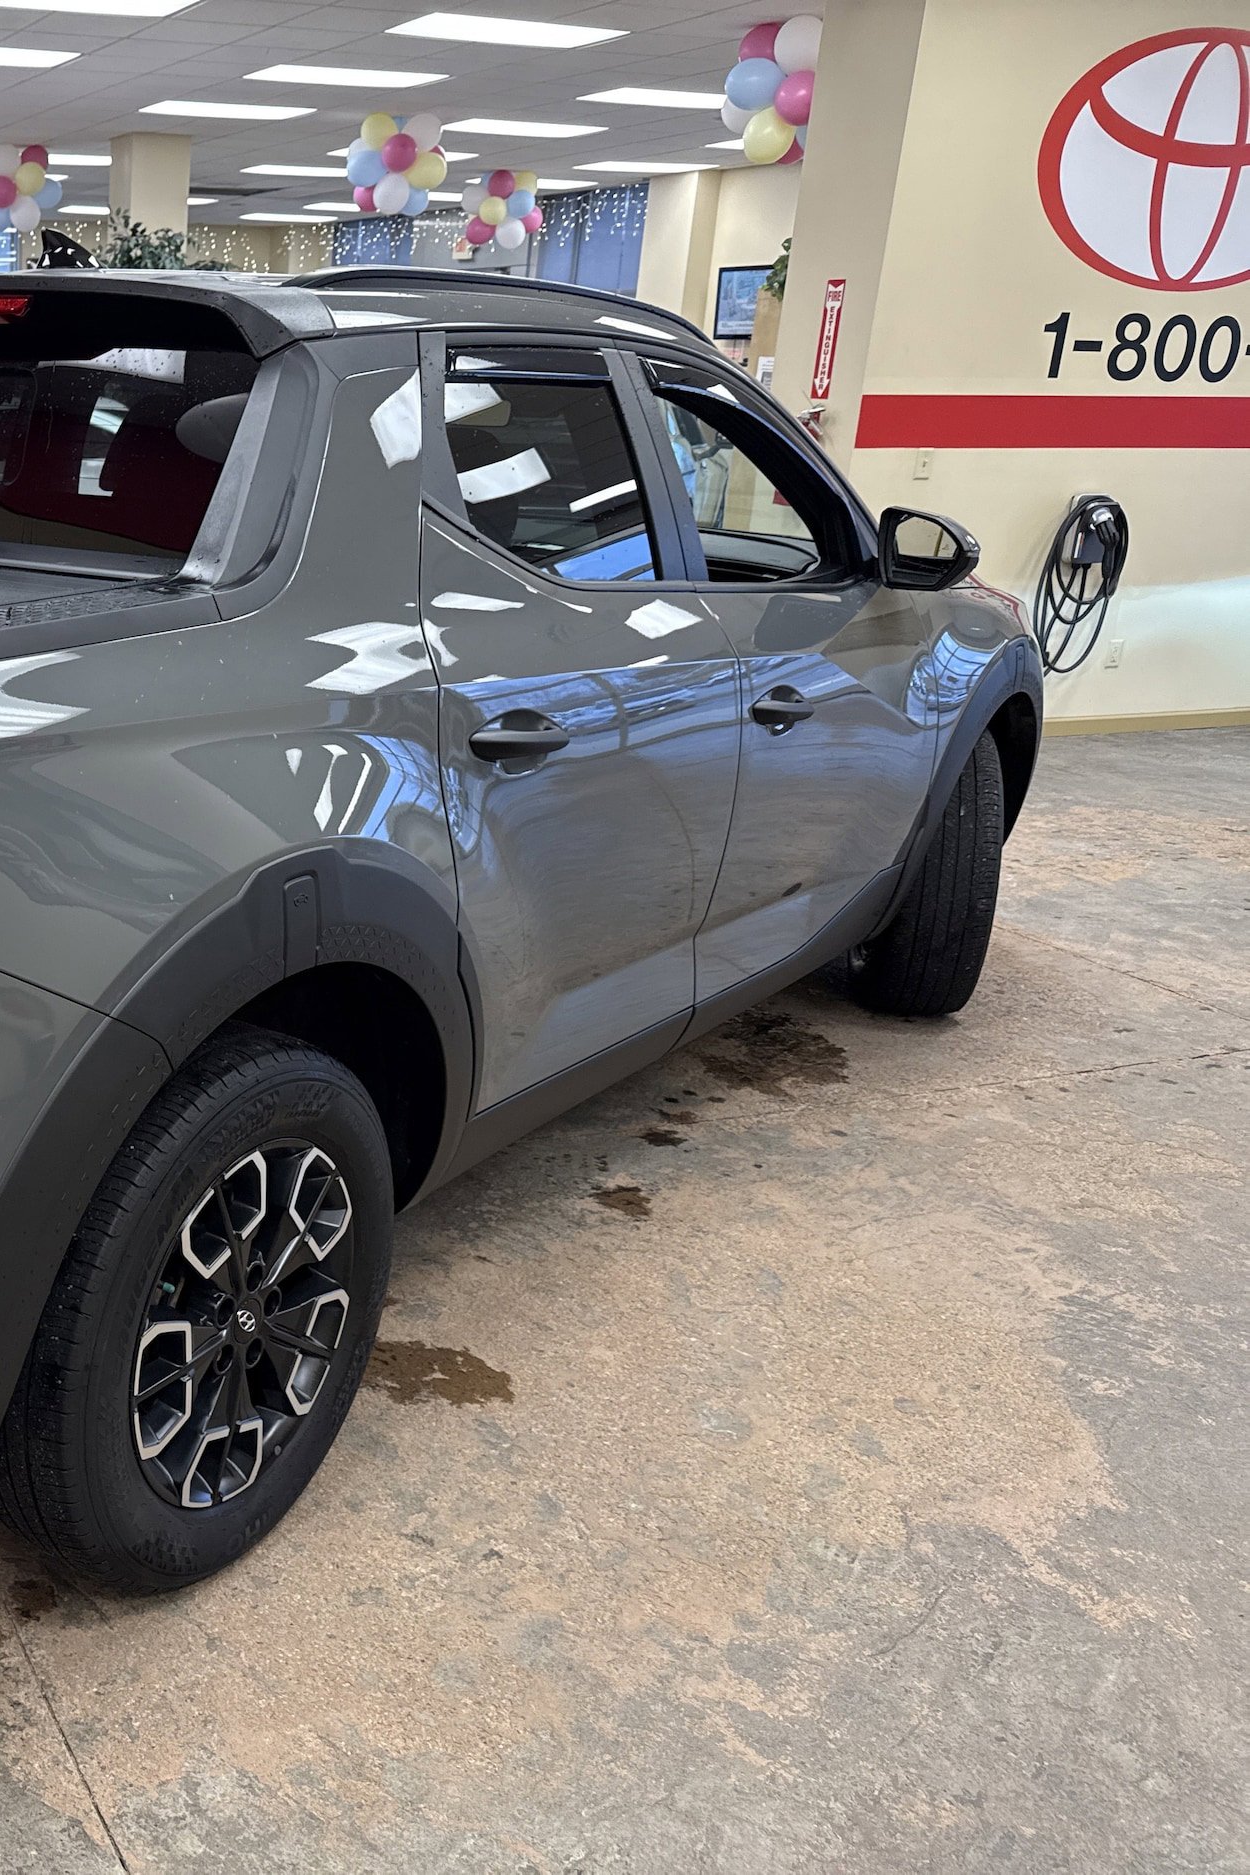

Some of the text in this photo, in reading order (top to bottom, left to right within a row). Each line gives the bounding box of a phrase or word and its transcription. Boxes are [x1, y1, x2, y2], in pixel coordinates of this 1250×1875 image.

[827, 290, 842, 302] FIRE
[818, 306, 836, 390] EXTINGUISHER
[1044, 312, 1250, 383] 1-800
